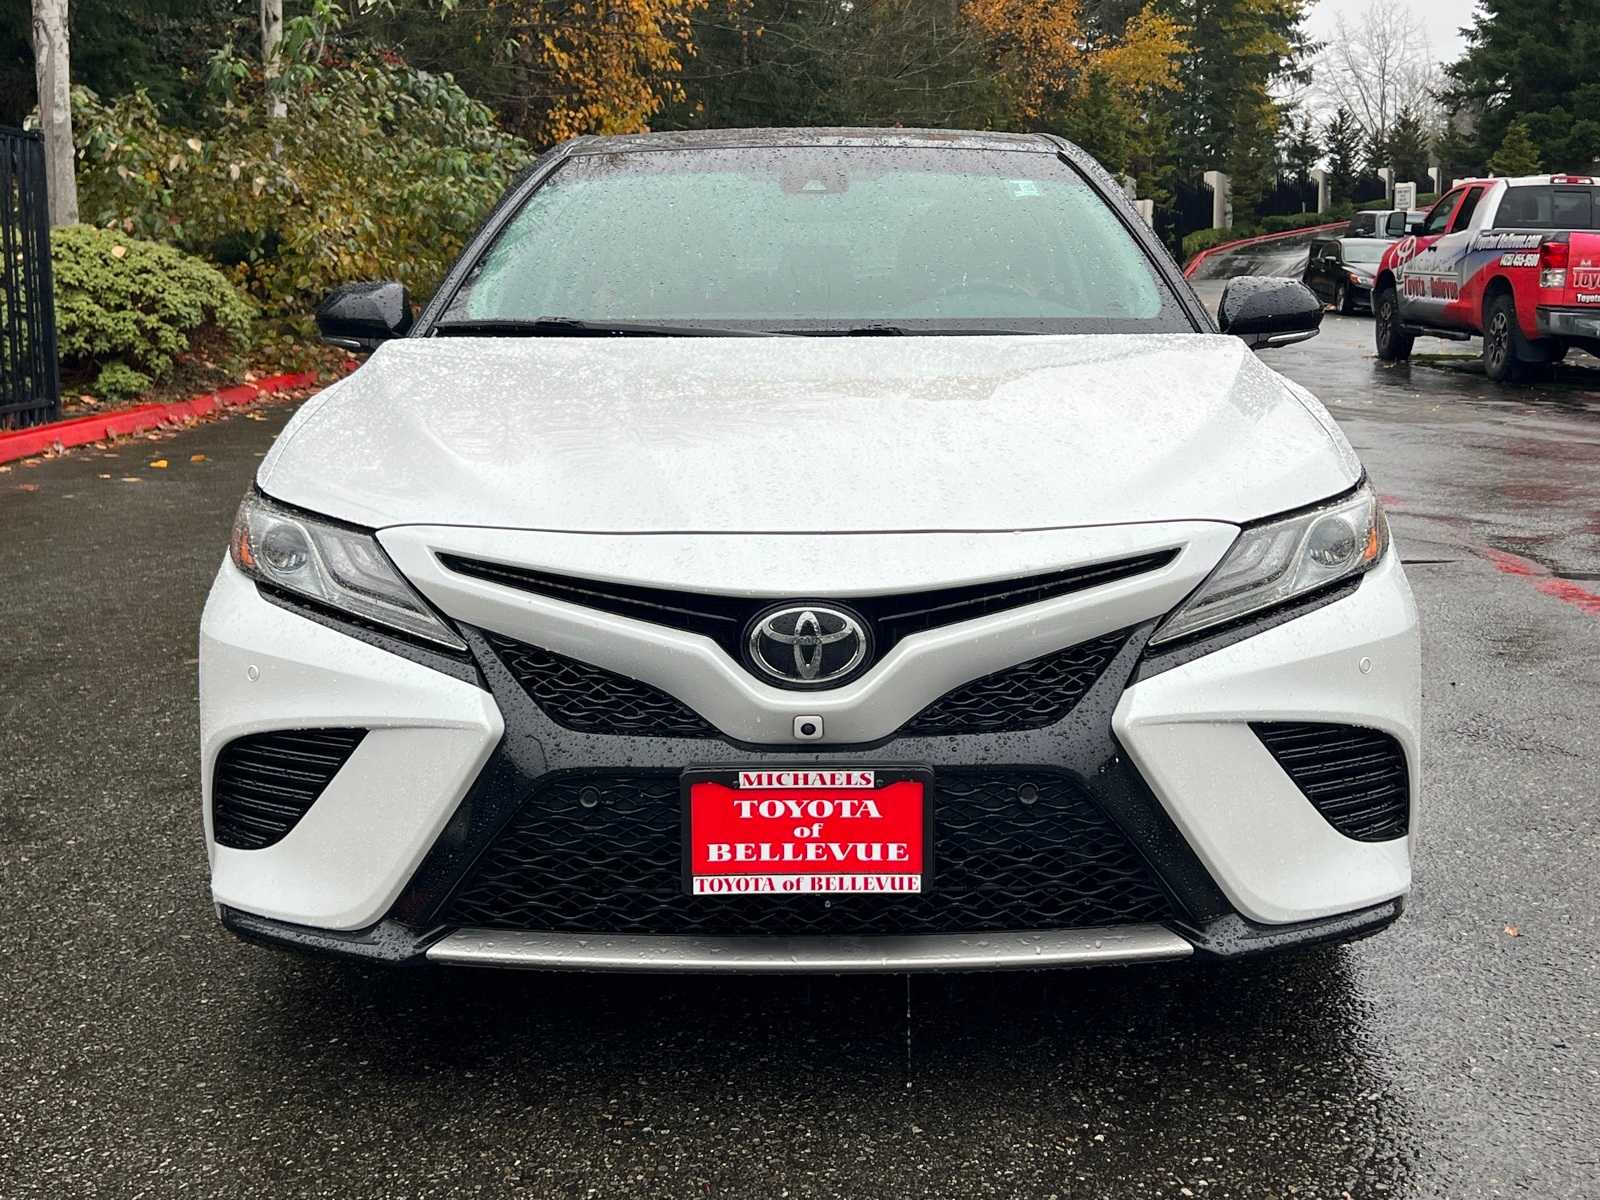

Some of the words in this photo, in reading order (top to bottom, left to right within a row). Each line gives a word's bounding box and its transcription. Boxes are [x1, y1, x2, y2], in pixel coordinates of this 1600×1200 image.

[742, 772, 872, 786] MICHAELS
[733, 799, 883, 819] TOYOTA
[793, 823, 824, 839] of
[706, 843, 910, 862] BELLEVUE
[695, 878, 776, 892] TOYOTA
[782, 877, 802, 891] of
[810, 876, 919, 891] BELLEVUE
